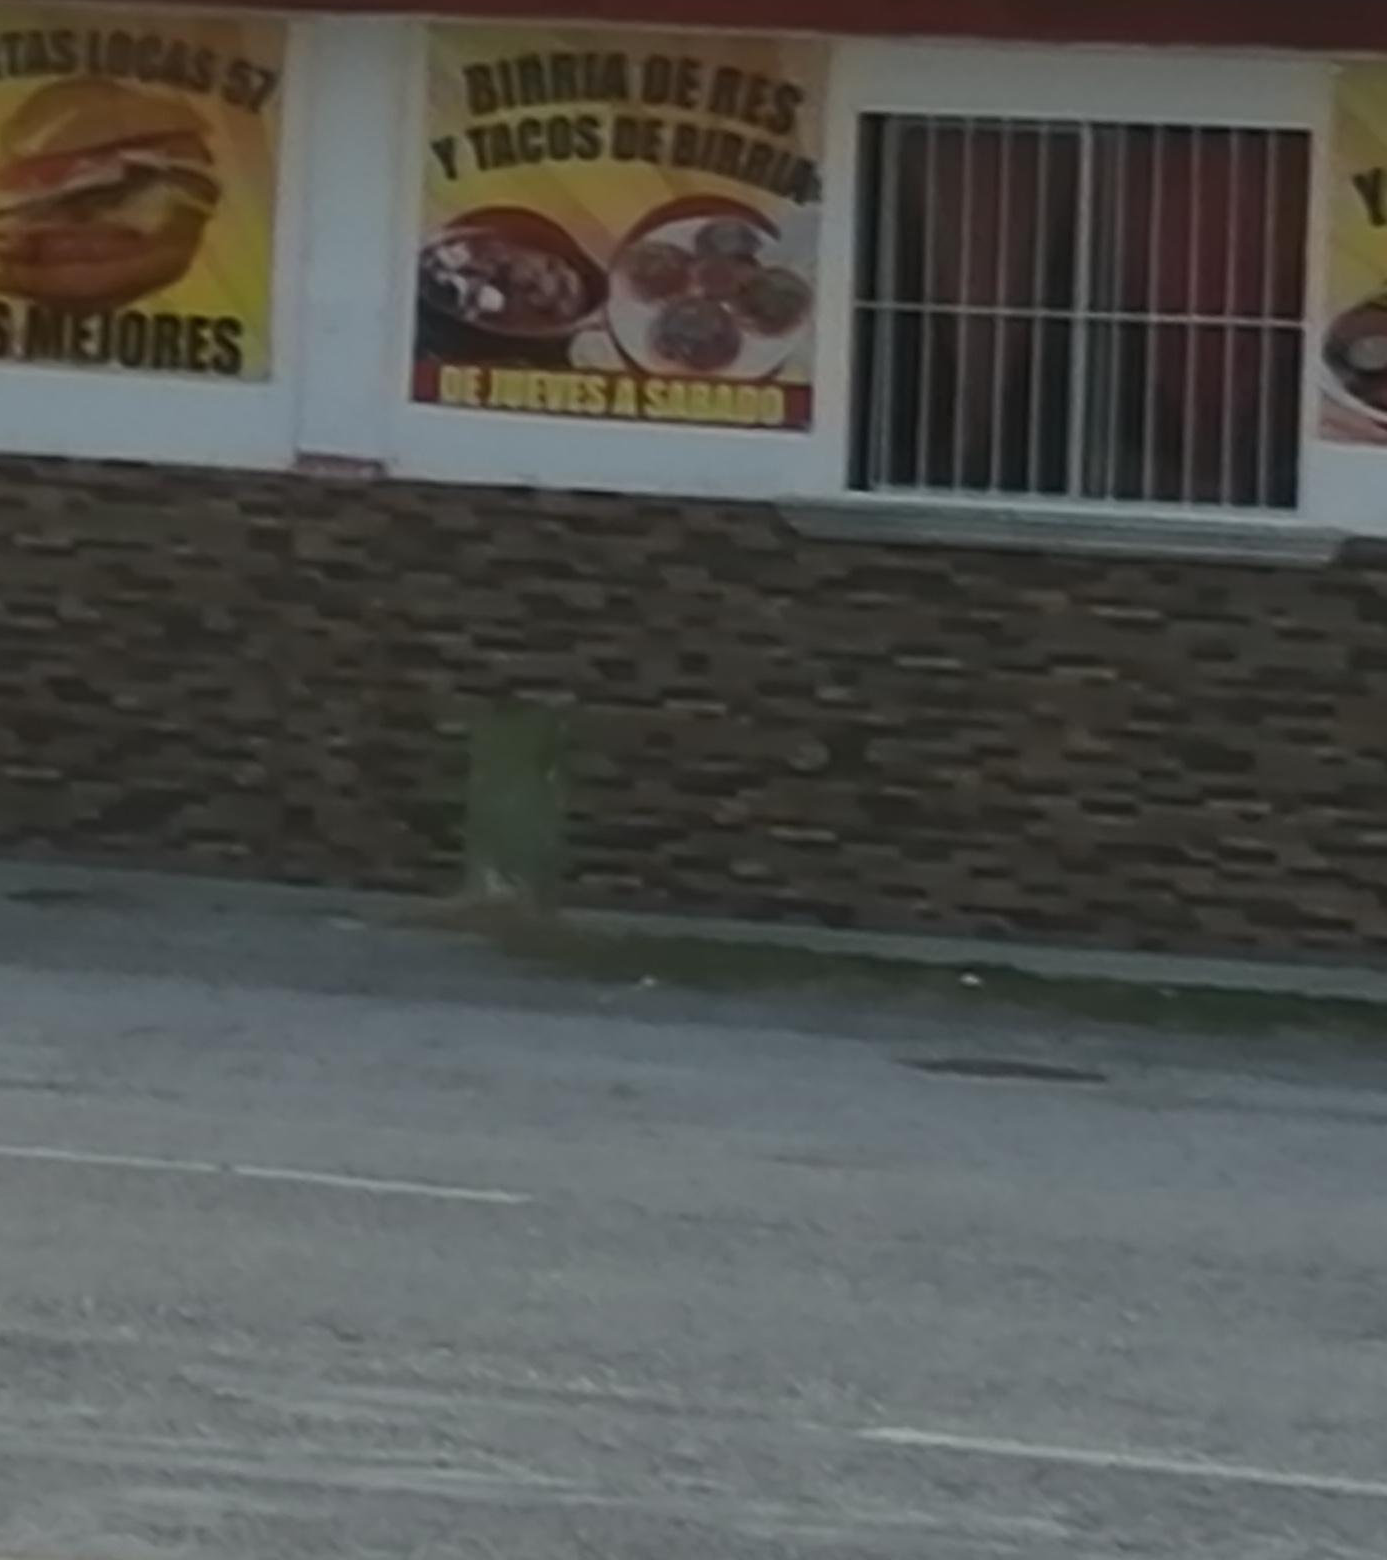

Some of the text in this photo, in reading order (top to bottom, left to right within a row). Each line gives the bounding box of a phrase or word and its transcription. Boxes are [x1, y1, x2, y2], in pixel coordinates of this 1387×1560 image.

[87, 28, 213, 93] LOCAS
[221, 60, 278, 114] 57
[463, 51, 805, 135] BIRRIA DE RES
[432, 115, 824, 206] Y TACOS DE BIRRIA
[24, 310, 244, 375] MEJORES
[439, 365, 787, 426] DE JUEVES A SABADO
